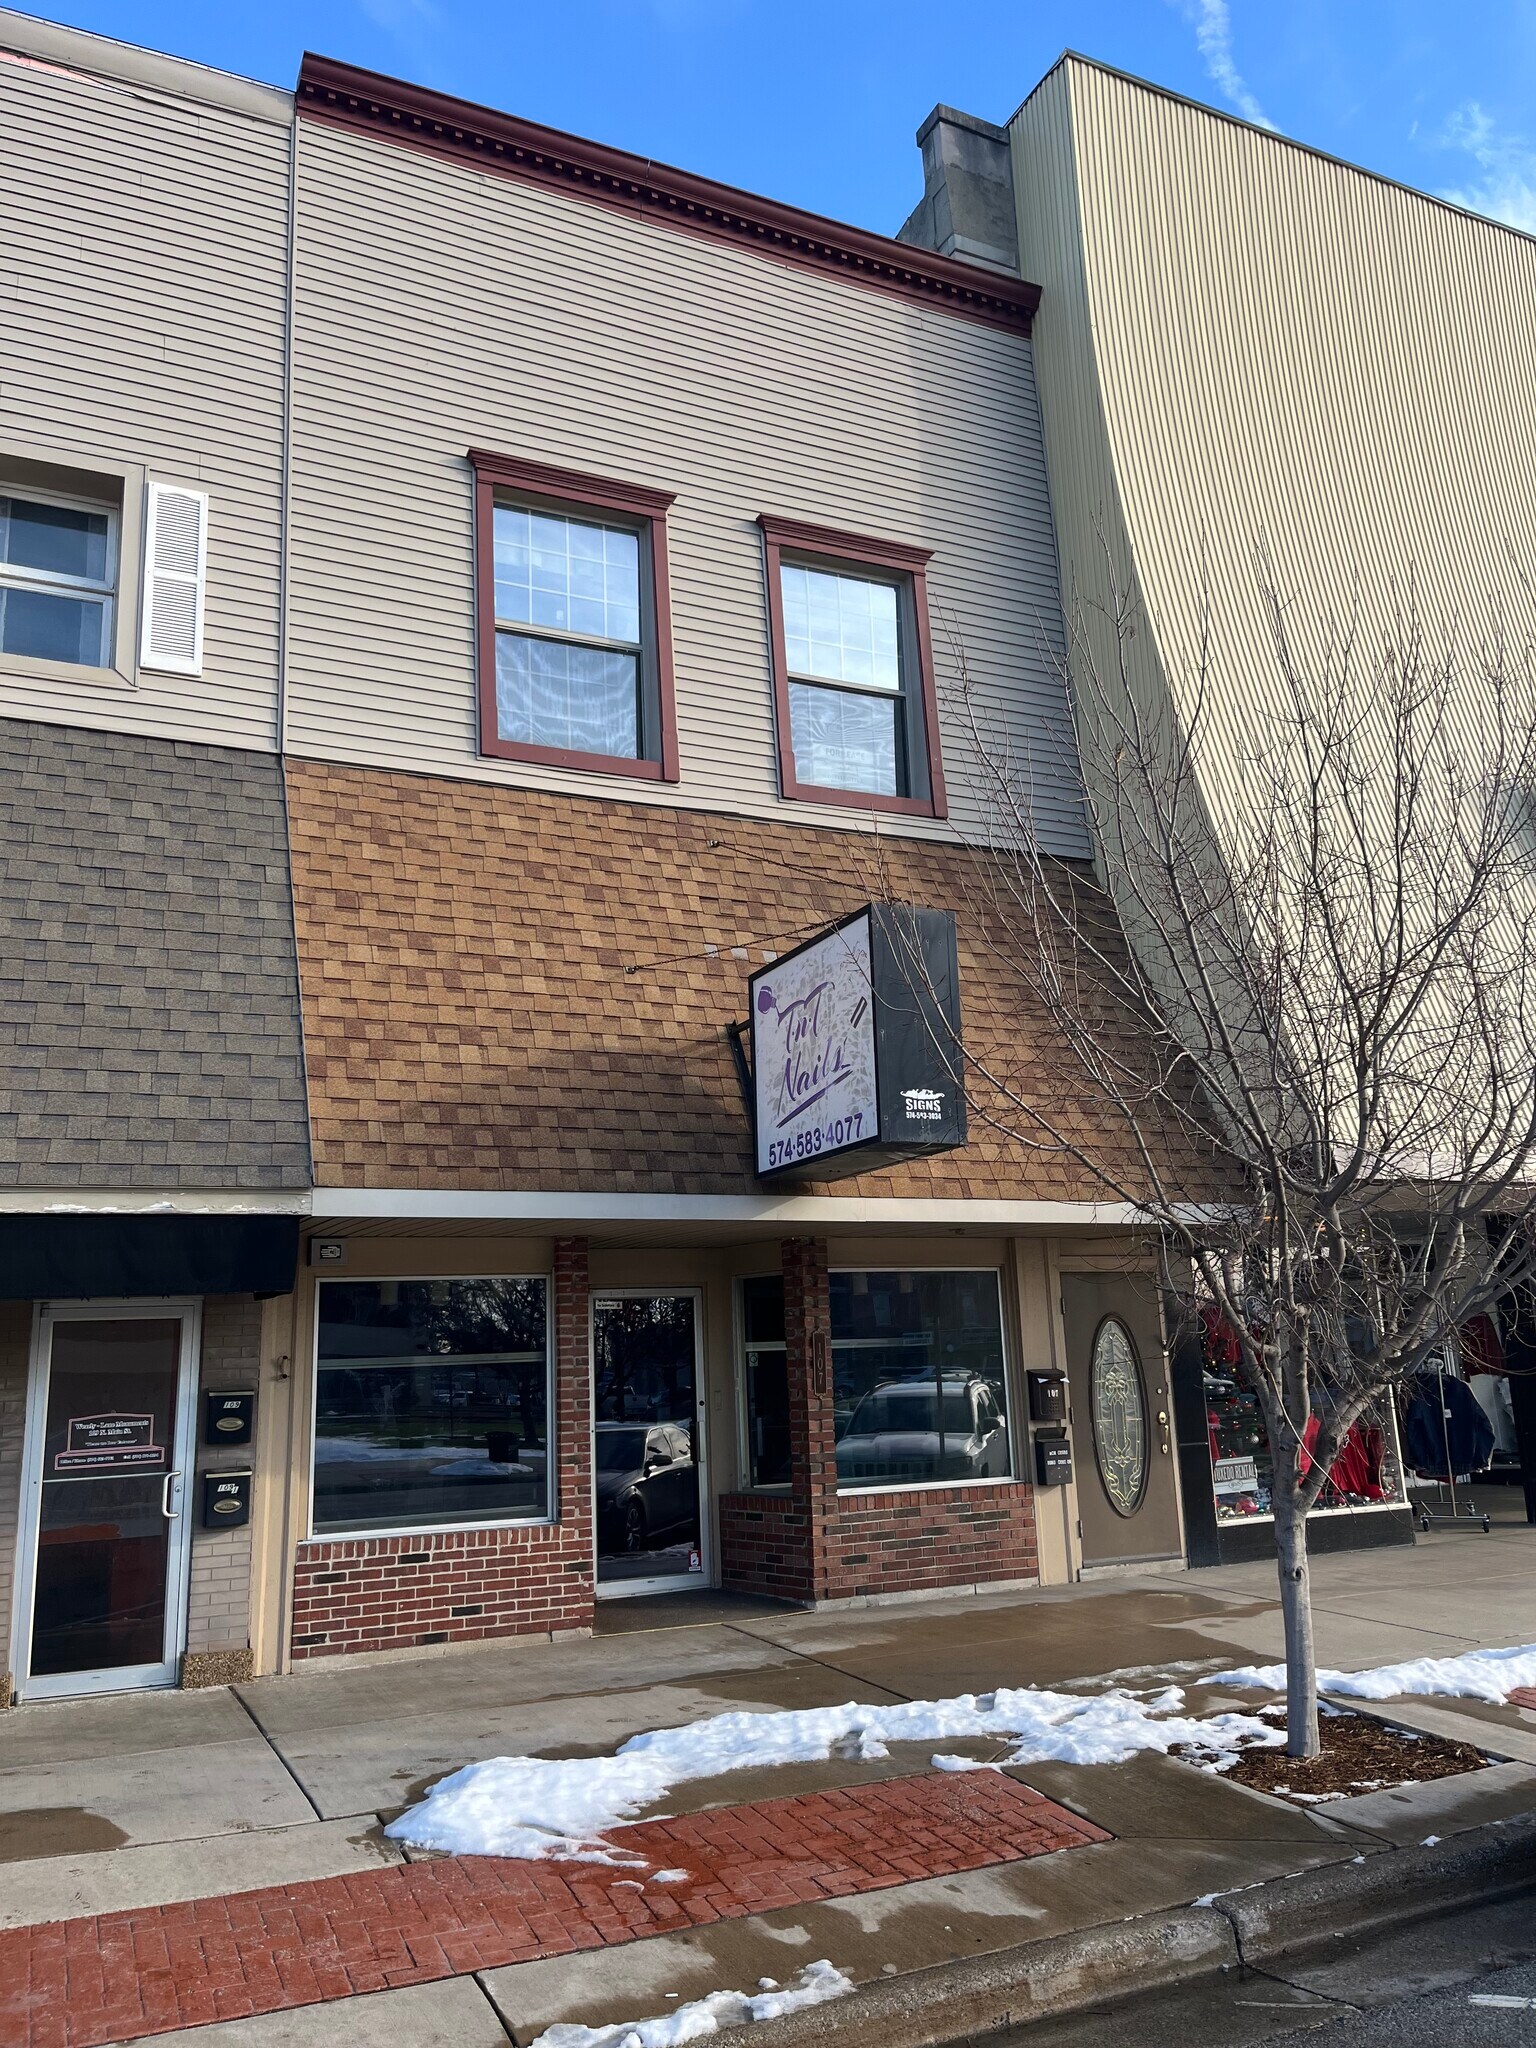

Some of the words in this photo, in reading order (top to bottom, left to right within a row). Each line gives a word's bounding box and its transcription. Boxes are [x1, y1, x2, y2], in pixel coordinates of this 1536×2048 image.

[777, 1036, 851, 1117] Nails
[905, 1098, 941, 1112] SIGNS
[223, 1401, 241, 1409] 109
[1235, 1463, 1256, 1479] RENTAL
